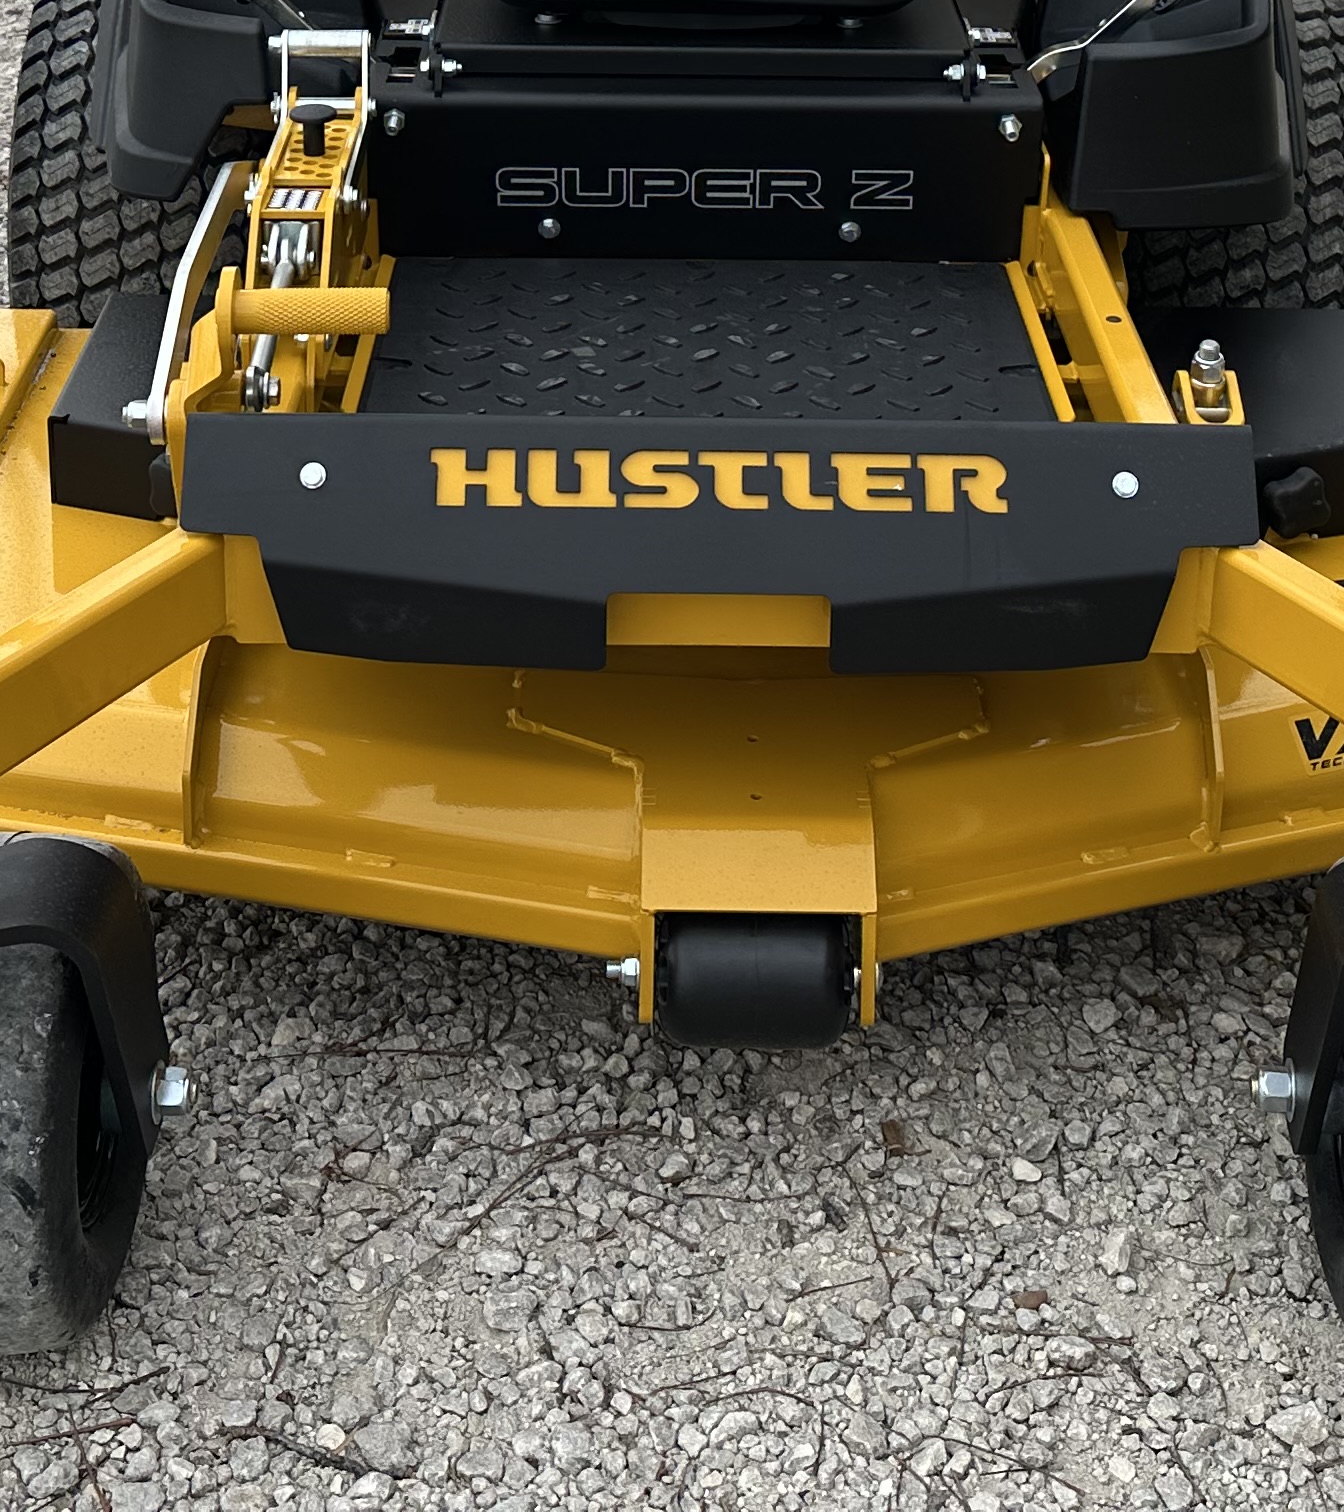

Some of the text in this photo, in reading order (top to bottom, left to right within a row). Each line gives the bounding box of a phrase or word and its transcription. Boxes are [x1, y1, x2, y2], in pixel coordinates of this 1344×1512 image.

[496, 167, 915, 211] SUPER Z
[430, 447, 1008, 514] HUSTLER
